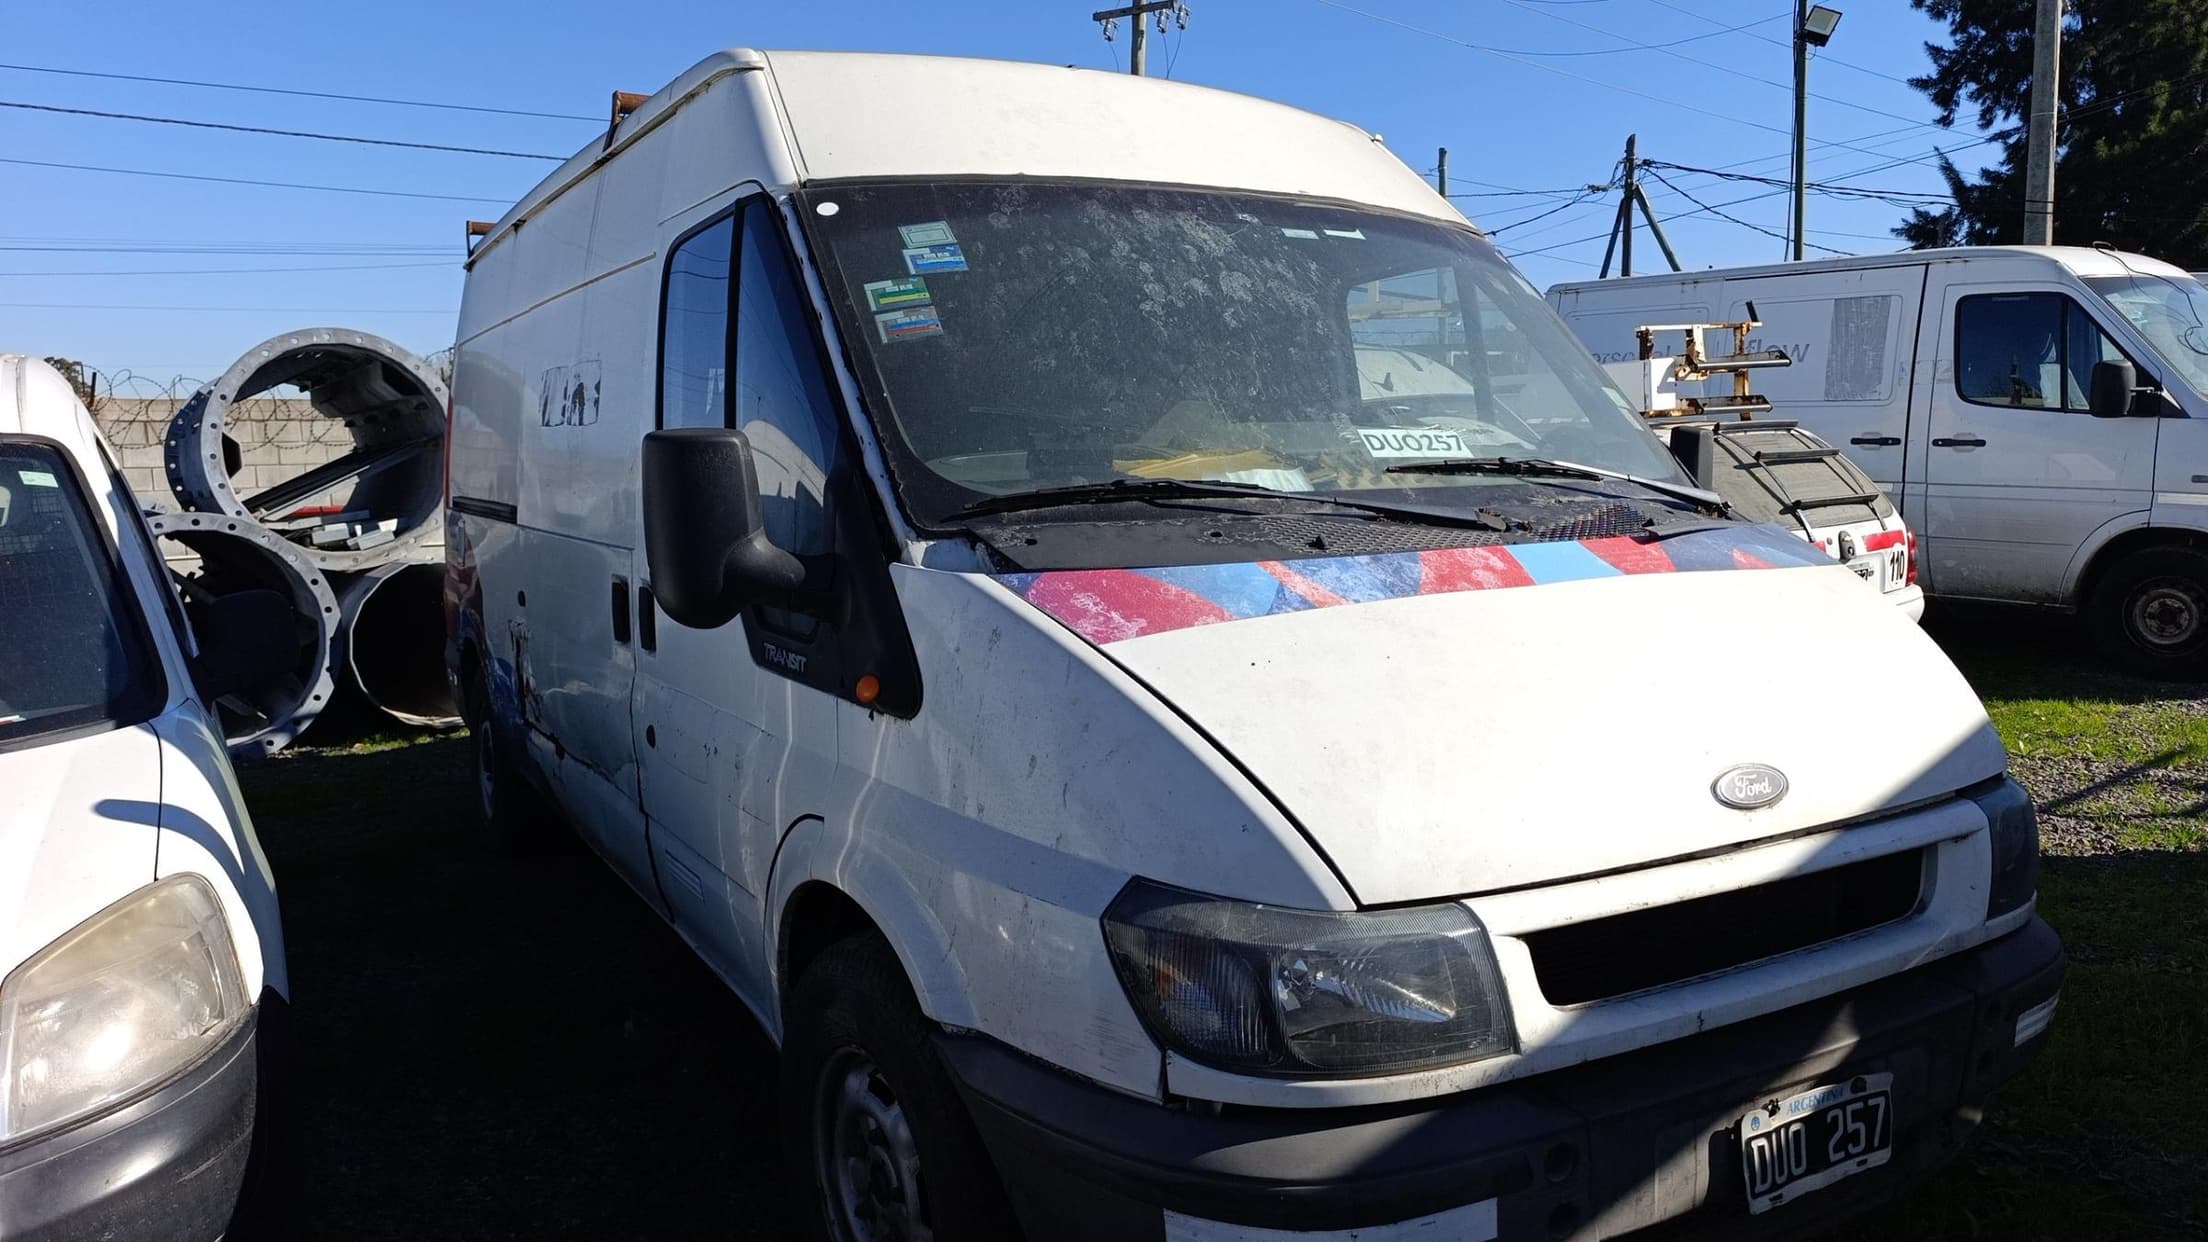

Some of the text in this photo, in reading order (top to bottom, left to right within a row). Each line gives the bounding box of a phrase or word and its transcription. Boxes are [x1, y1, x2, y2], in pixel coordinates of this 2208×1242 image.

[1363, 434, 1463, 451] DUO257
[1890, 550, 1905, 582] 110
[763, 642, 807, 672] TRANSIT
[1734, 774, 1772, 799] Ford
[1786, 1087, 1844, 1114] ARGENTINA
[1751, 1096, 1886, 1193] DUO 257
